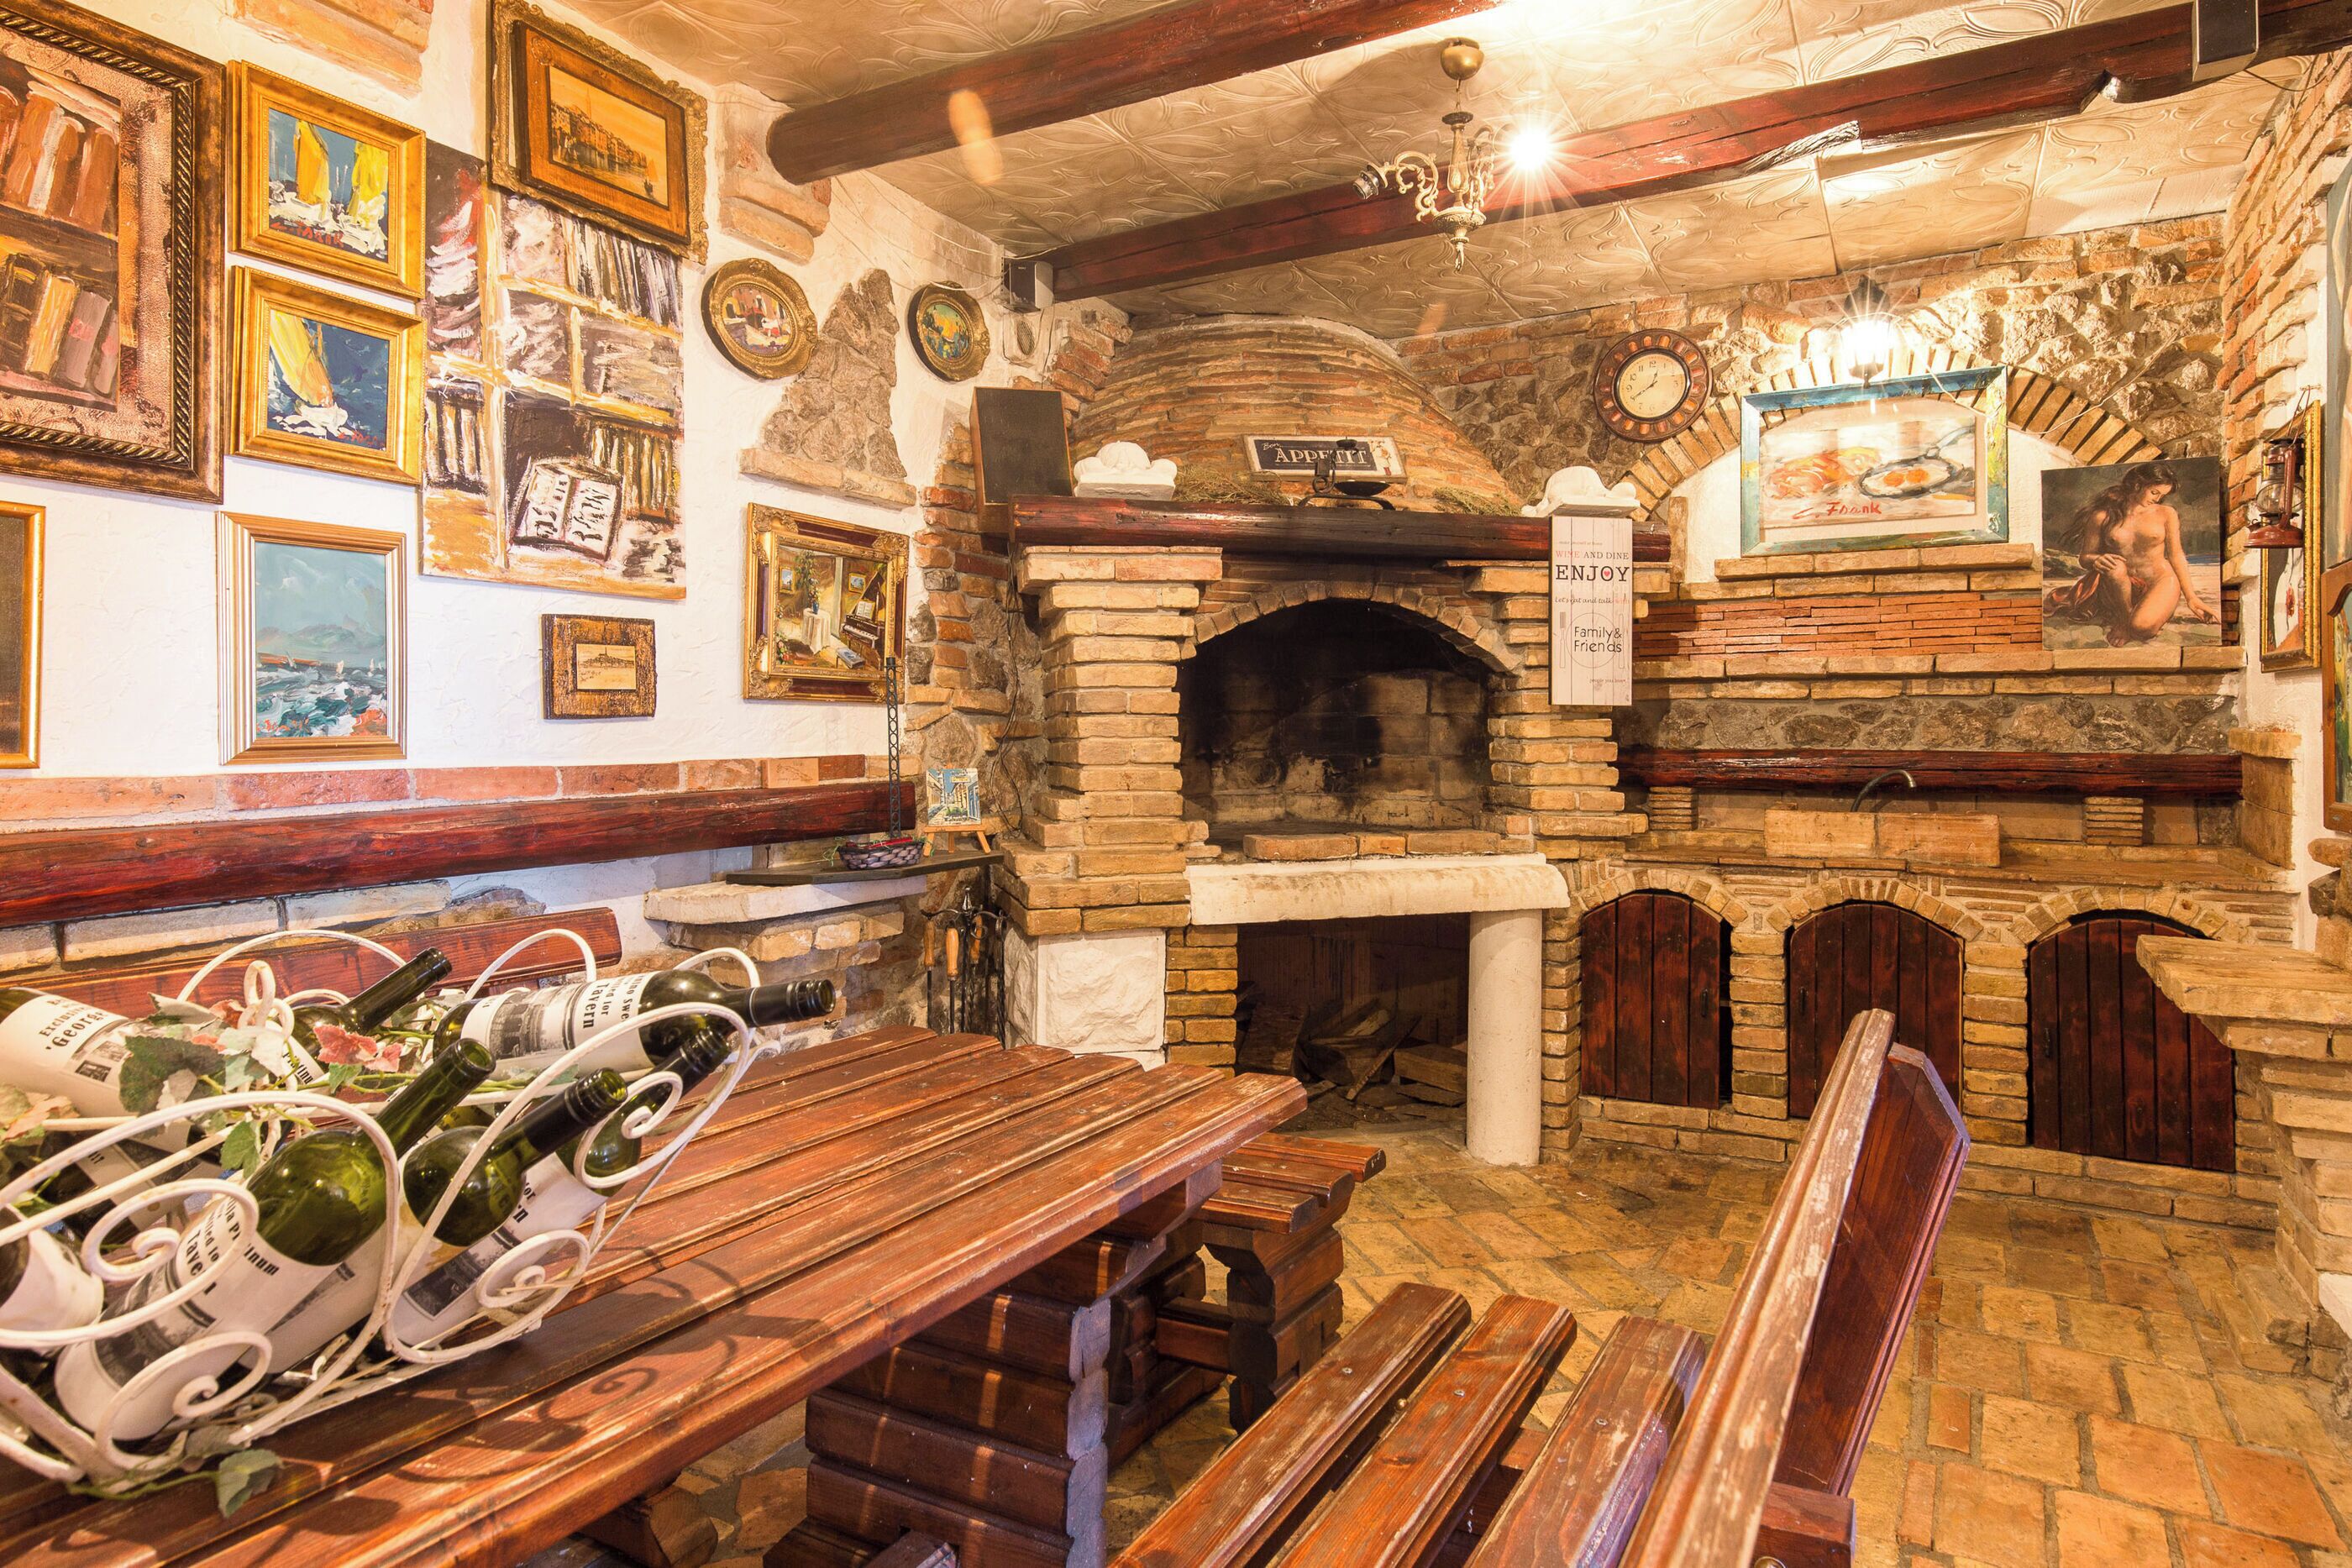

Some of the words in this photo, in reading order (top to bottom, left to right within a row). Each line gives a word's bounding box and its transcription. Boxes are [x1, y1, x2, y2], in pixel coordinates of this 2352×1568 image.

[1630, 373, 1637, 381] 10
[1625, 384, 1633, 392] 9
[1274, 448, 1368, 464] APPETIT
[1556, 550, 1580, 559] WINE
[1583, 551, 1604, 559] AND
[1605, 552, 1630, 560] DINE
[1555, 564, 1630, 582] ENJOY
[1574, 639, 1622, 653] Friends
[582, 983, 611, 1029] Tavern
